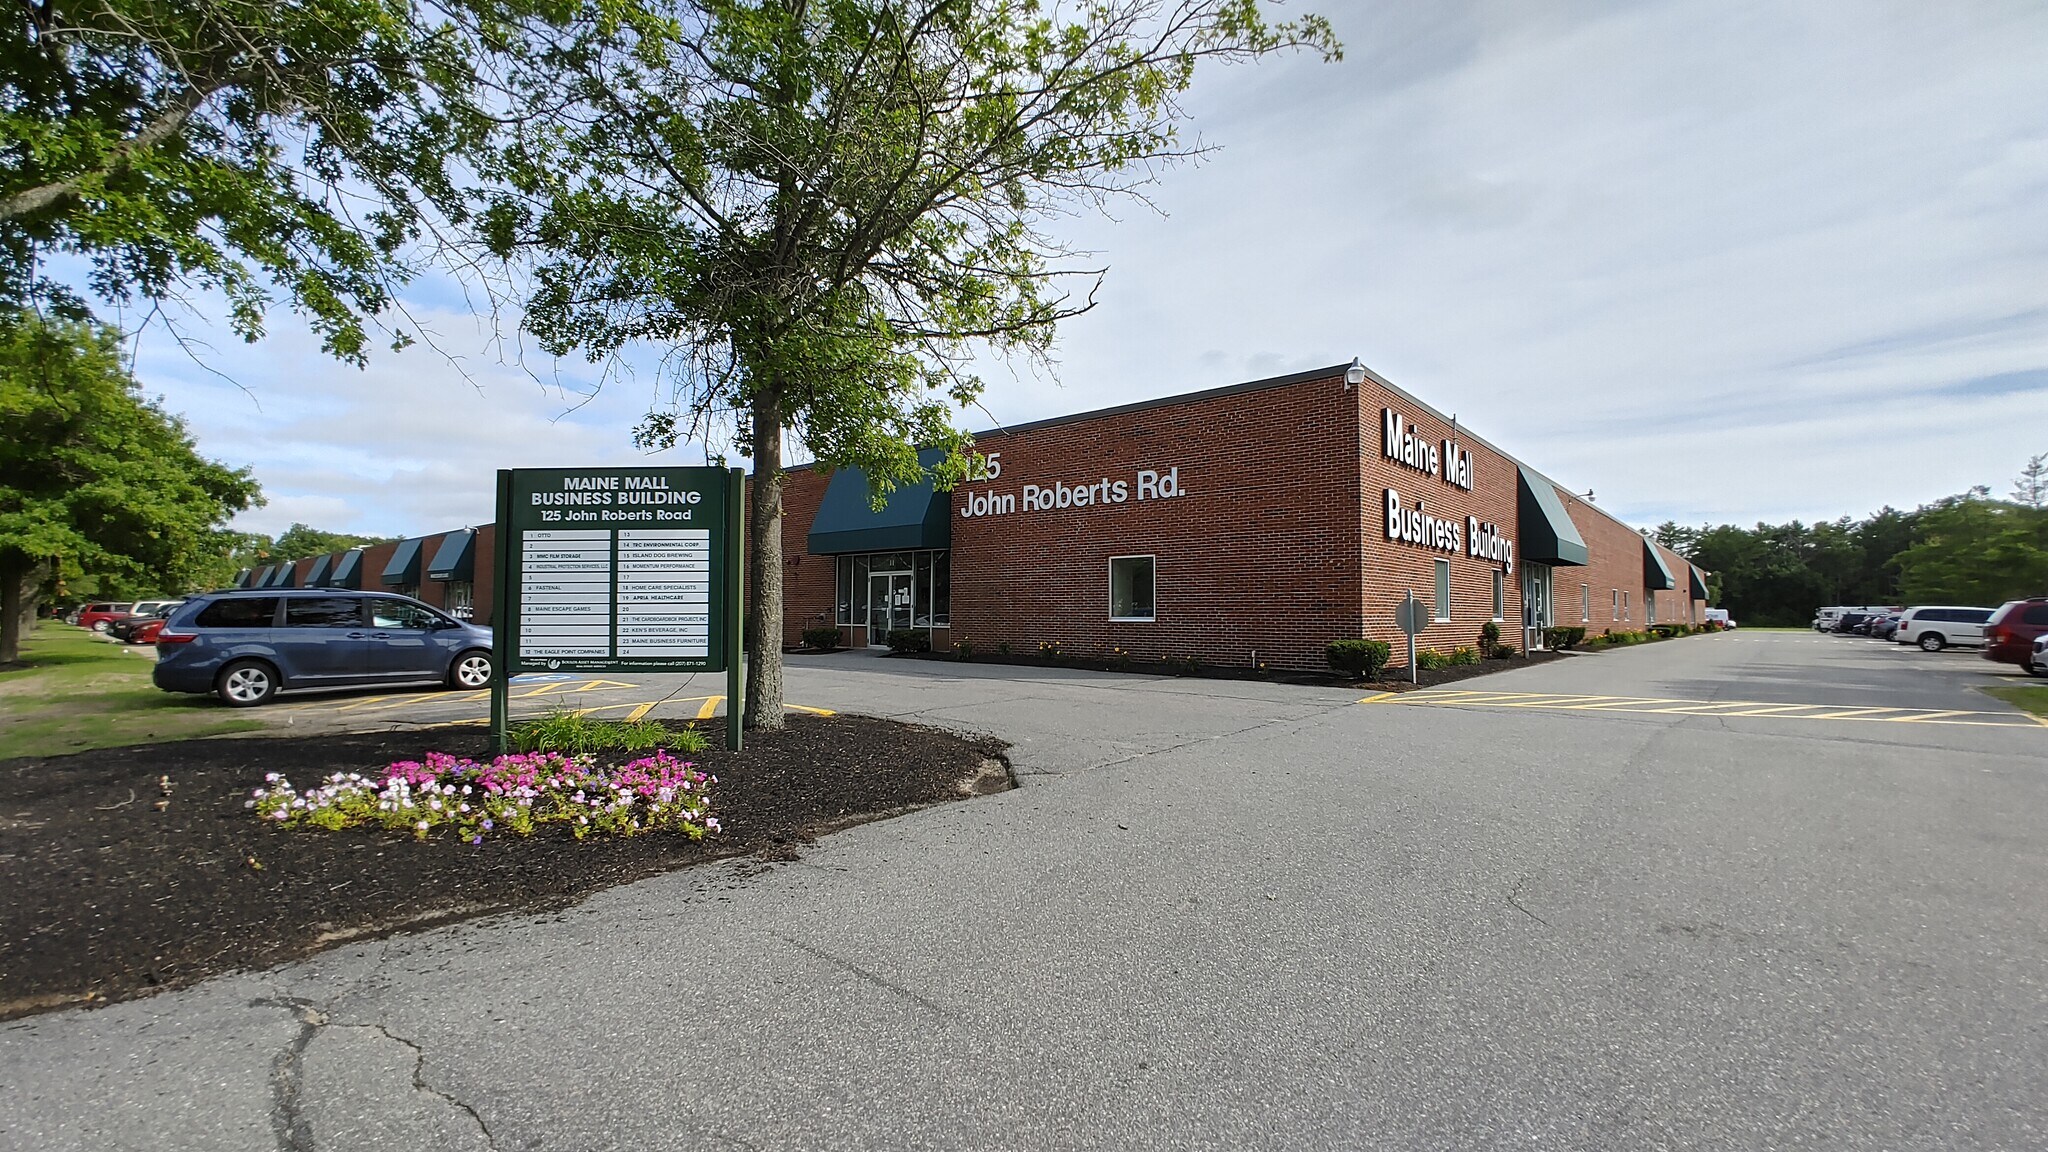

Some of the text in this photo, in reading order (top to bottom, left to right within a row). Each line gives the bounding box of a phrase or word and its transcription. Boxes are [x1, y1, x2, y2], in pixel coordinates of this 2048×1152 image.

[1384, 408, 1473, 490] Maine Mall
[532, 492, 702, 506] BUSINESS BUILDING
[564, 476, 670, 490] MAINE MALL
[961, 466, 1186, 518] John Roberts Rd.
[541, 509, 692, 521] 125 John Roberts Road
[1386, 488, 1512, 574] Business Building
